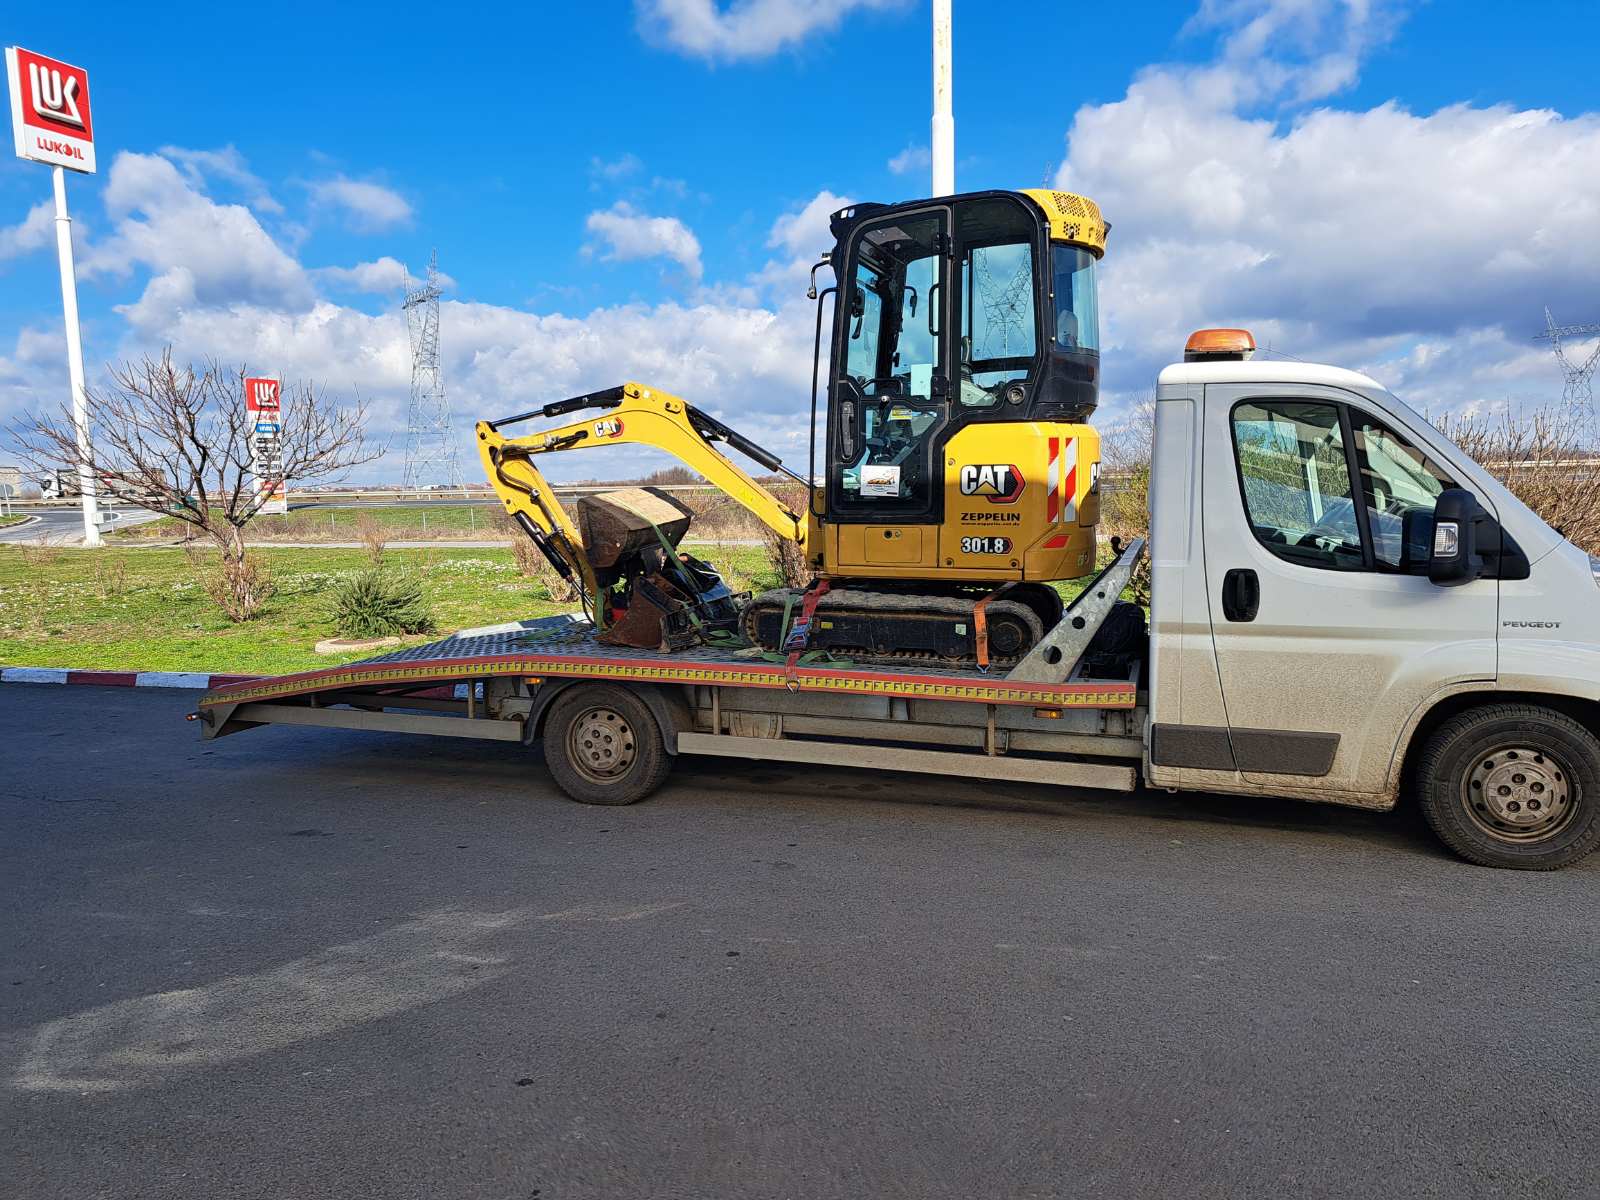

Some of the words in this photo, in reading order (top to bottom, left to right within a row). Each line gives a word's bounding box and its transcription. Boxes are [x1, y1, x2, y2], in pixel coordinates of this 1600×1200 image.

[36, 137, 84, 160] LUKOIL
[594, 418, 617, 437] CAT
[961, 465, 1010, 495] CAT
[960, 512, 1021, 521] ZEPPELIN
[961, 537, 1004, 553] 301.8
[1502, 620, 1562, 629] PEUGEOT
